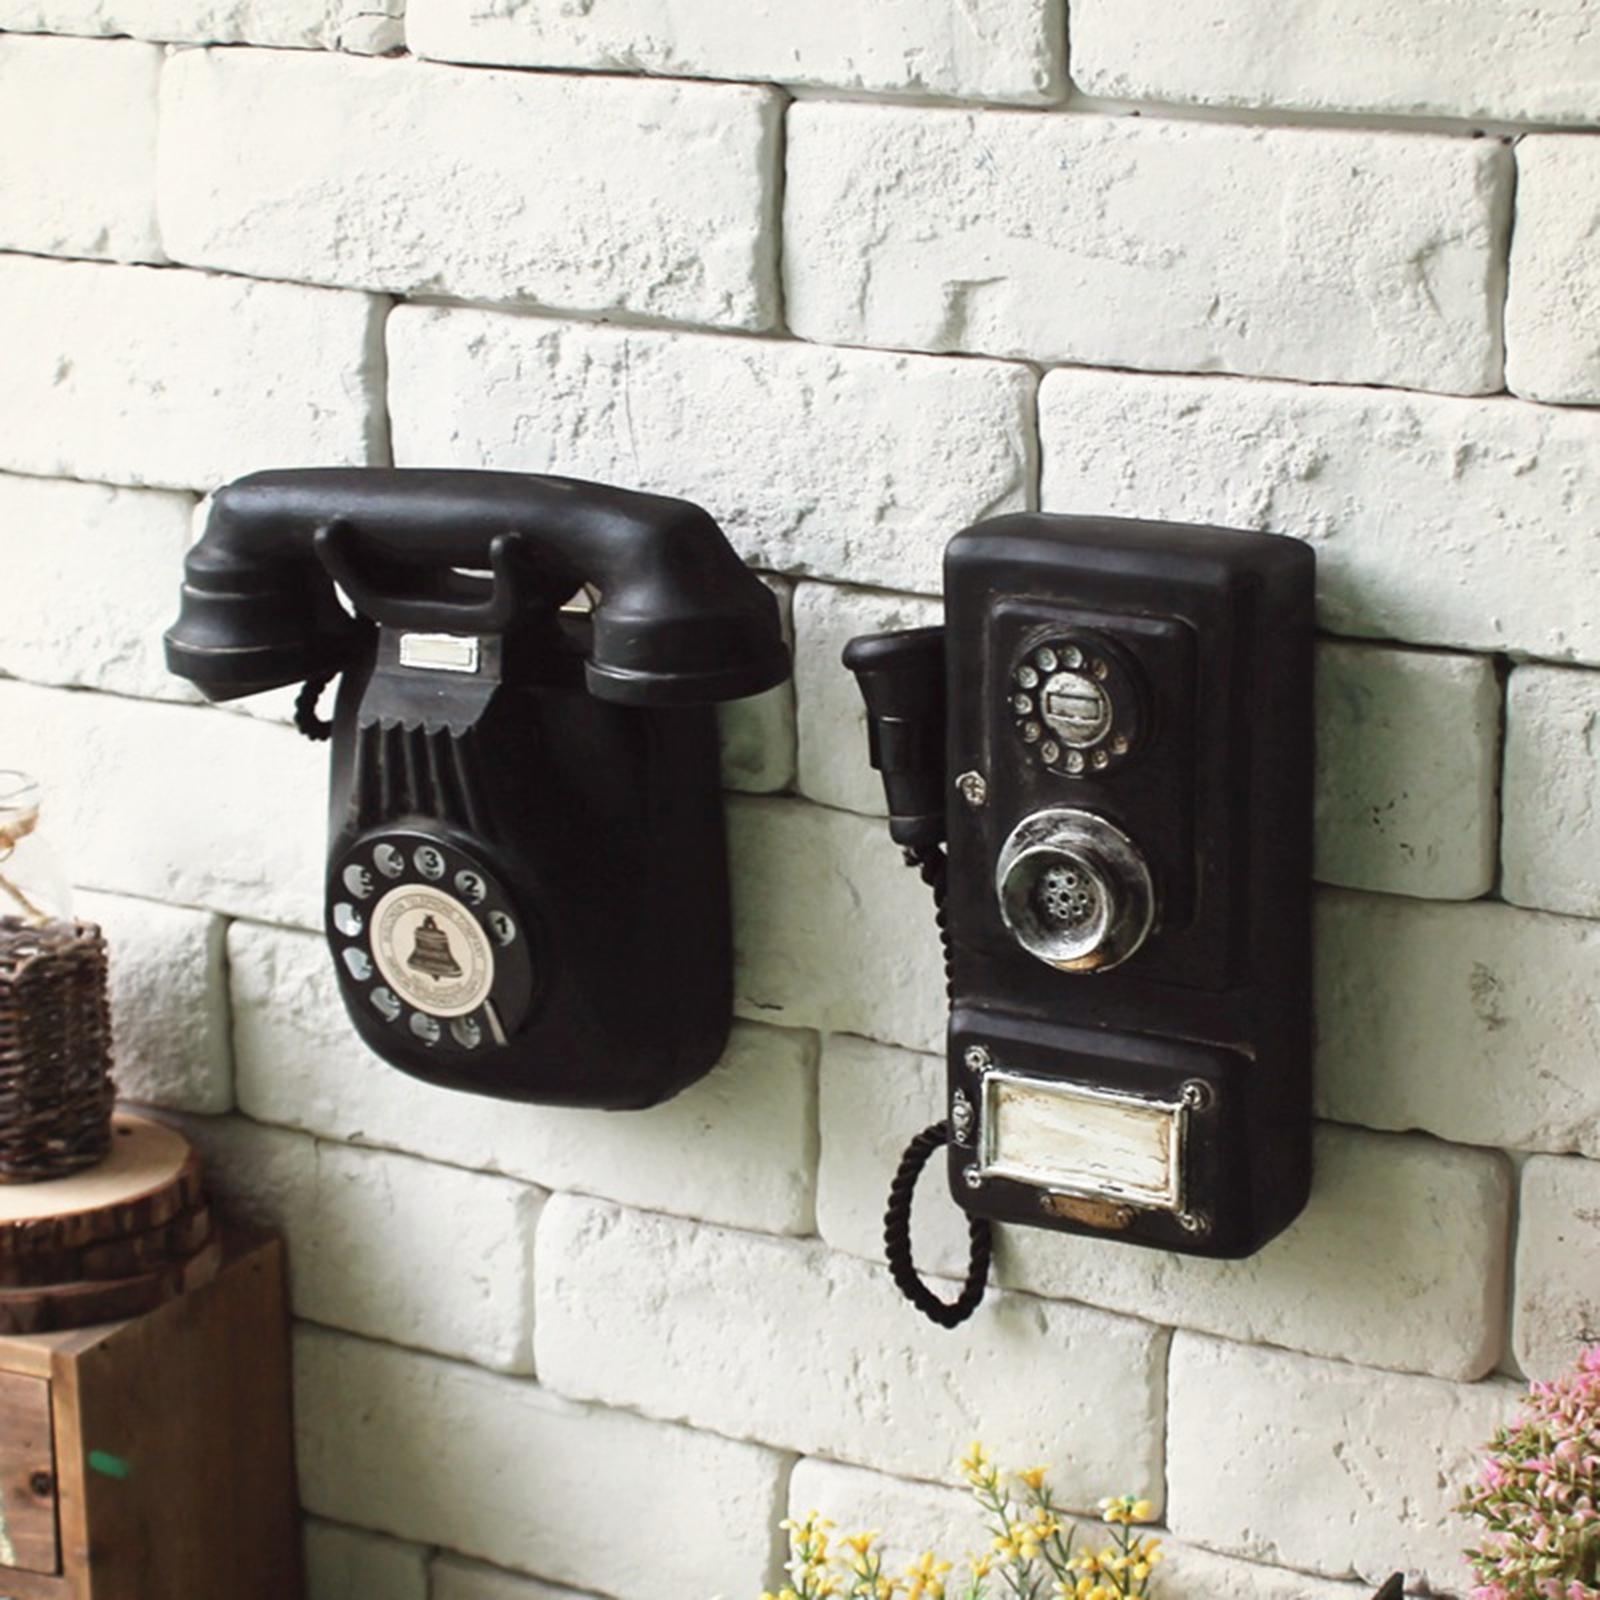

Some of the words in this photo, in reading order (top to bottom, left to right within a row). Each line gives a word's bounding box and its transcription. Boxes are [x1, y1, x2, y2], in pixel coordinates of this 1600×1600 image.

[425, 851, 439, 868] 3
[464, 875, 479, 893] 2
[495, 916, 507, 934] 1
